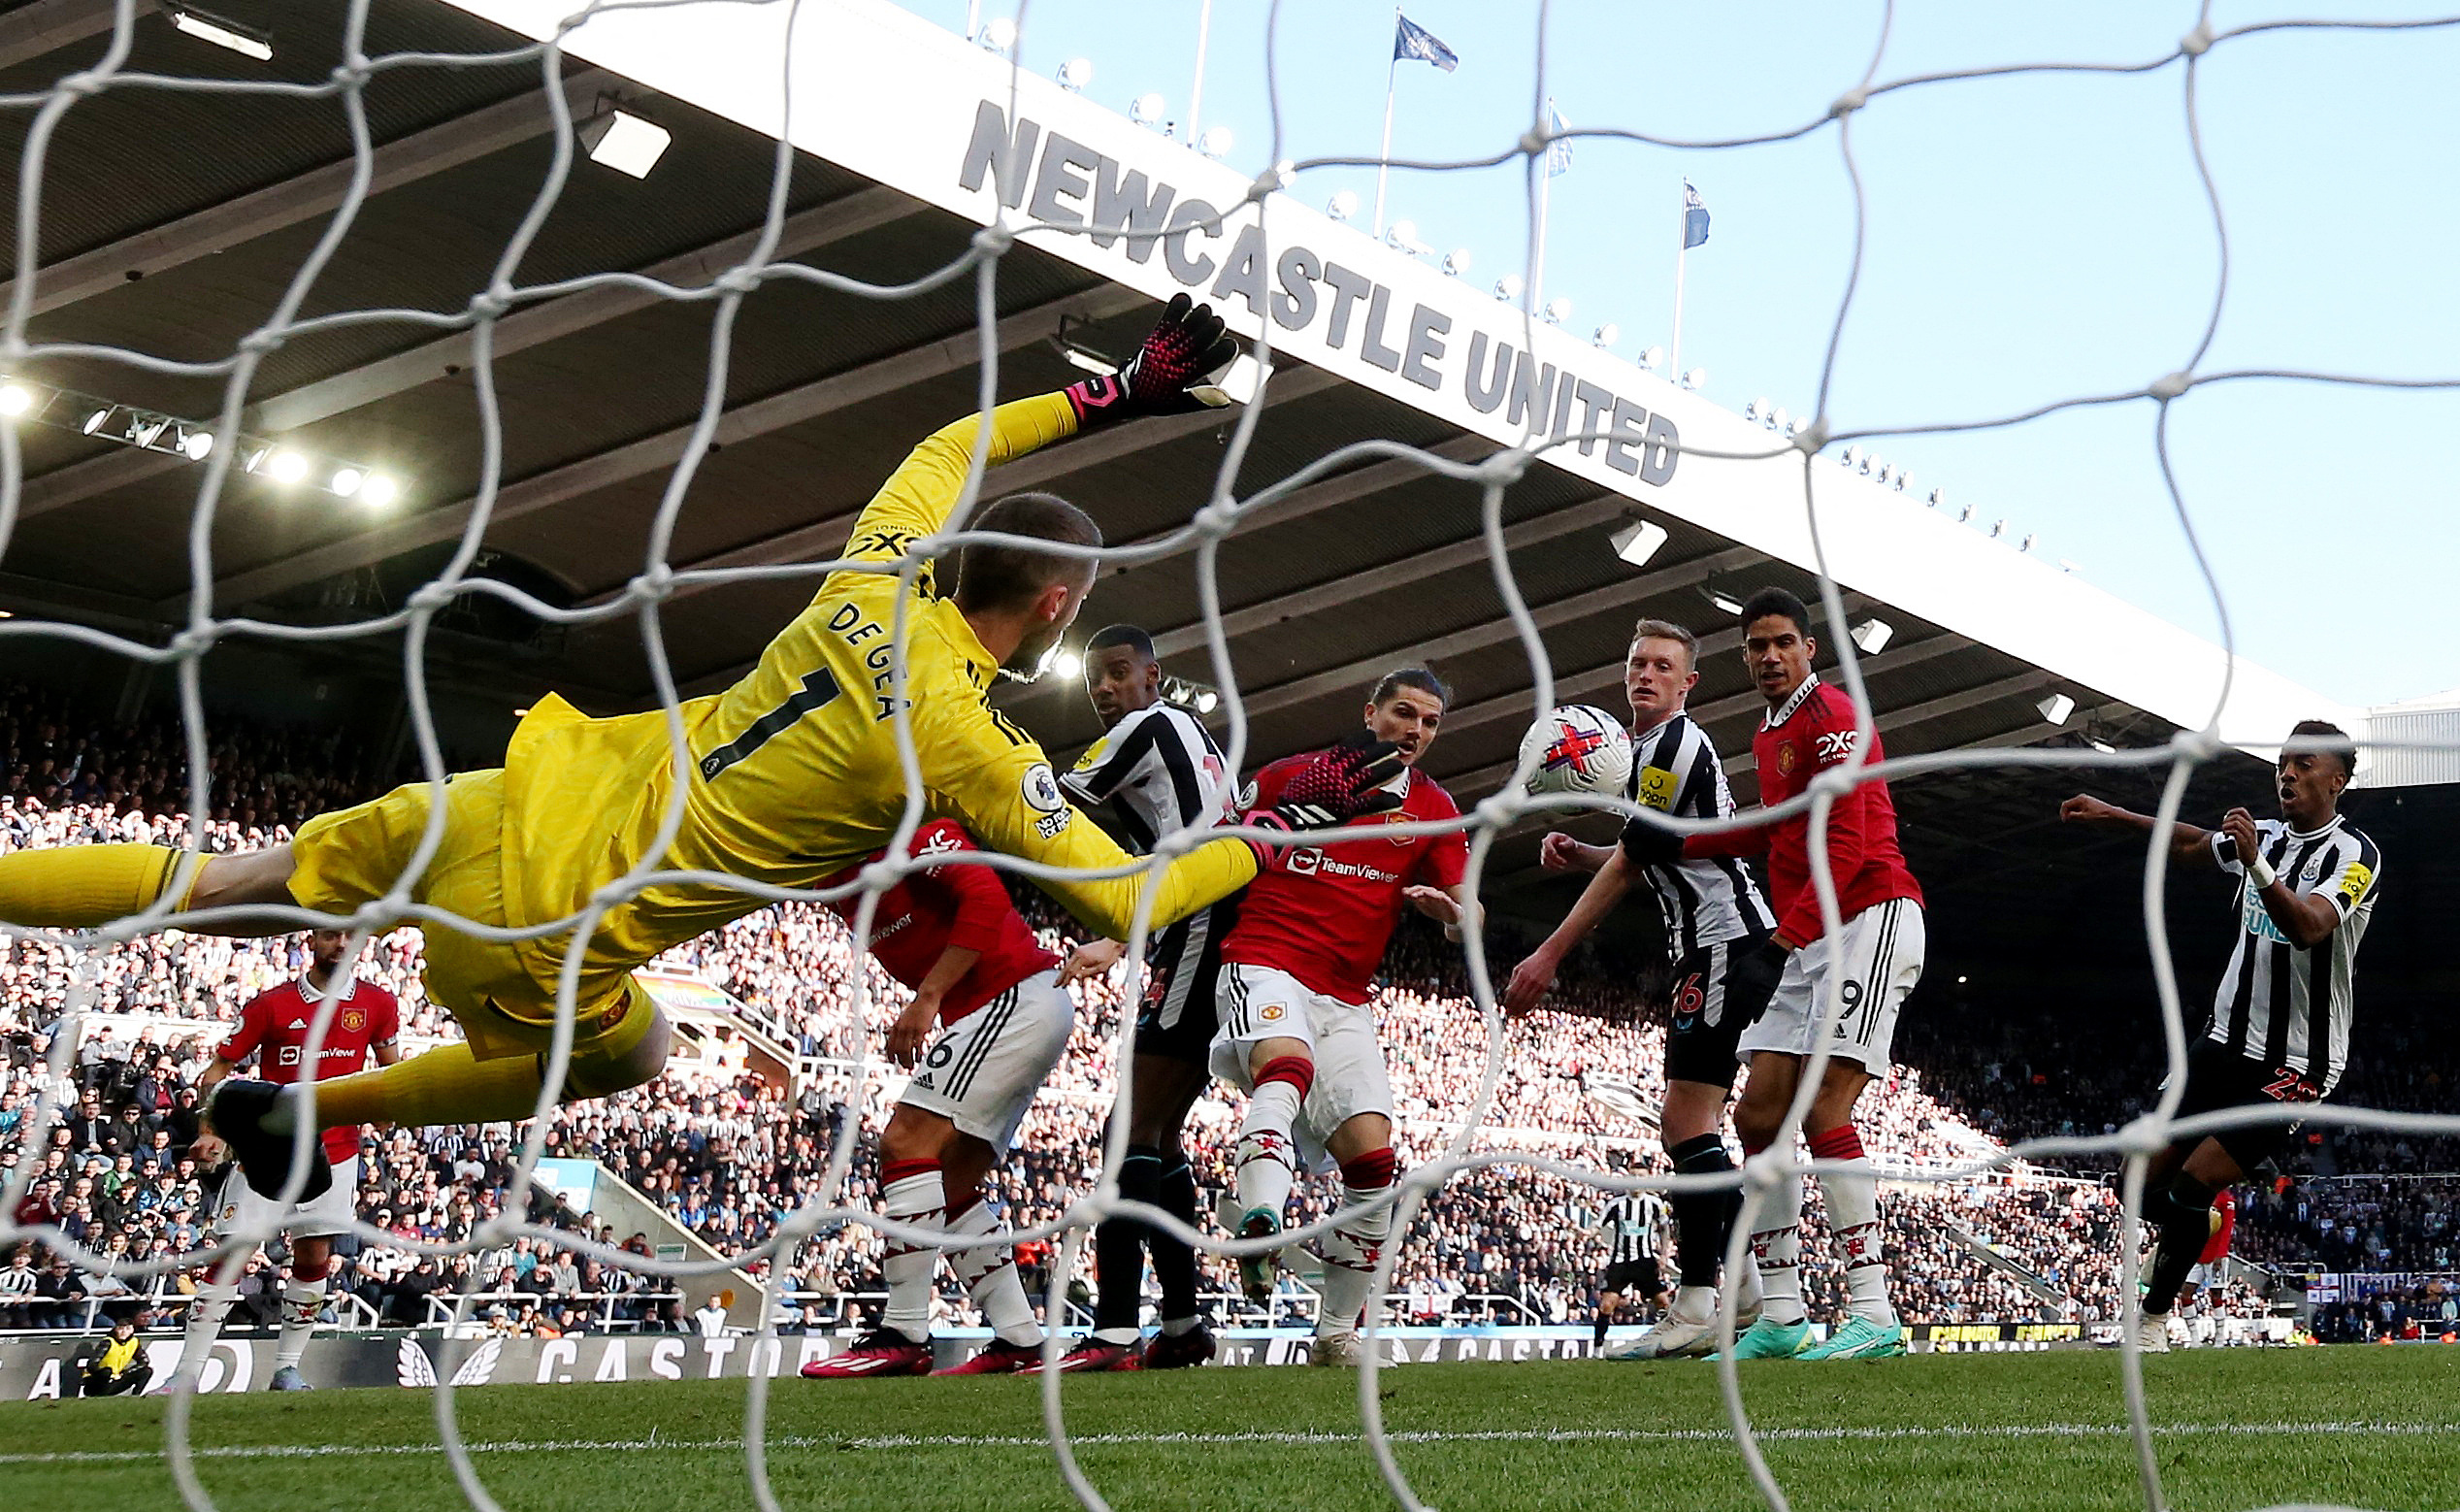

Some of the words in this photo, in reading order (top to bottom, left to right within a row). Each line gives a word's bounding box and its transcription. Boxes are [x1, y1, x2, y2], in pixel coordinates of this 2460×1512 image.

[959, 98, 1454, 392] NEWCASTLE
[1464, 329, 1680, 488] UNITED
[827, 602, 885, 647] DE
[699, 665, 842, 784] 1
[1321, 856, 1399, 883] TeamViewer
